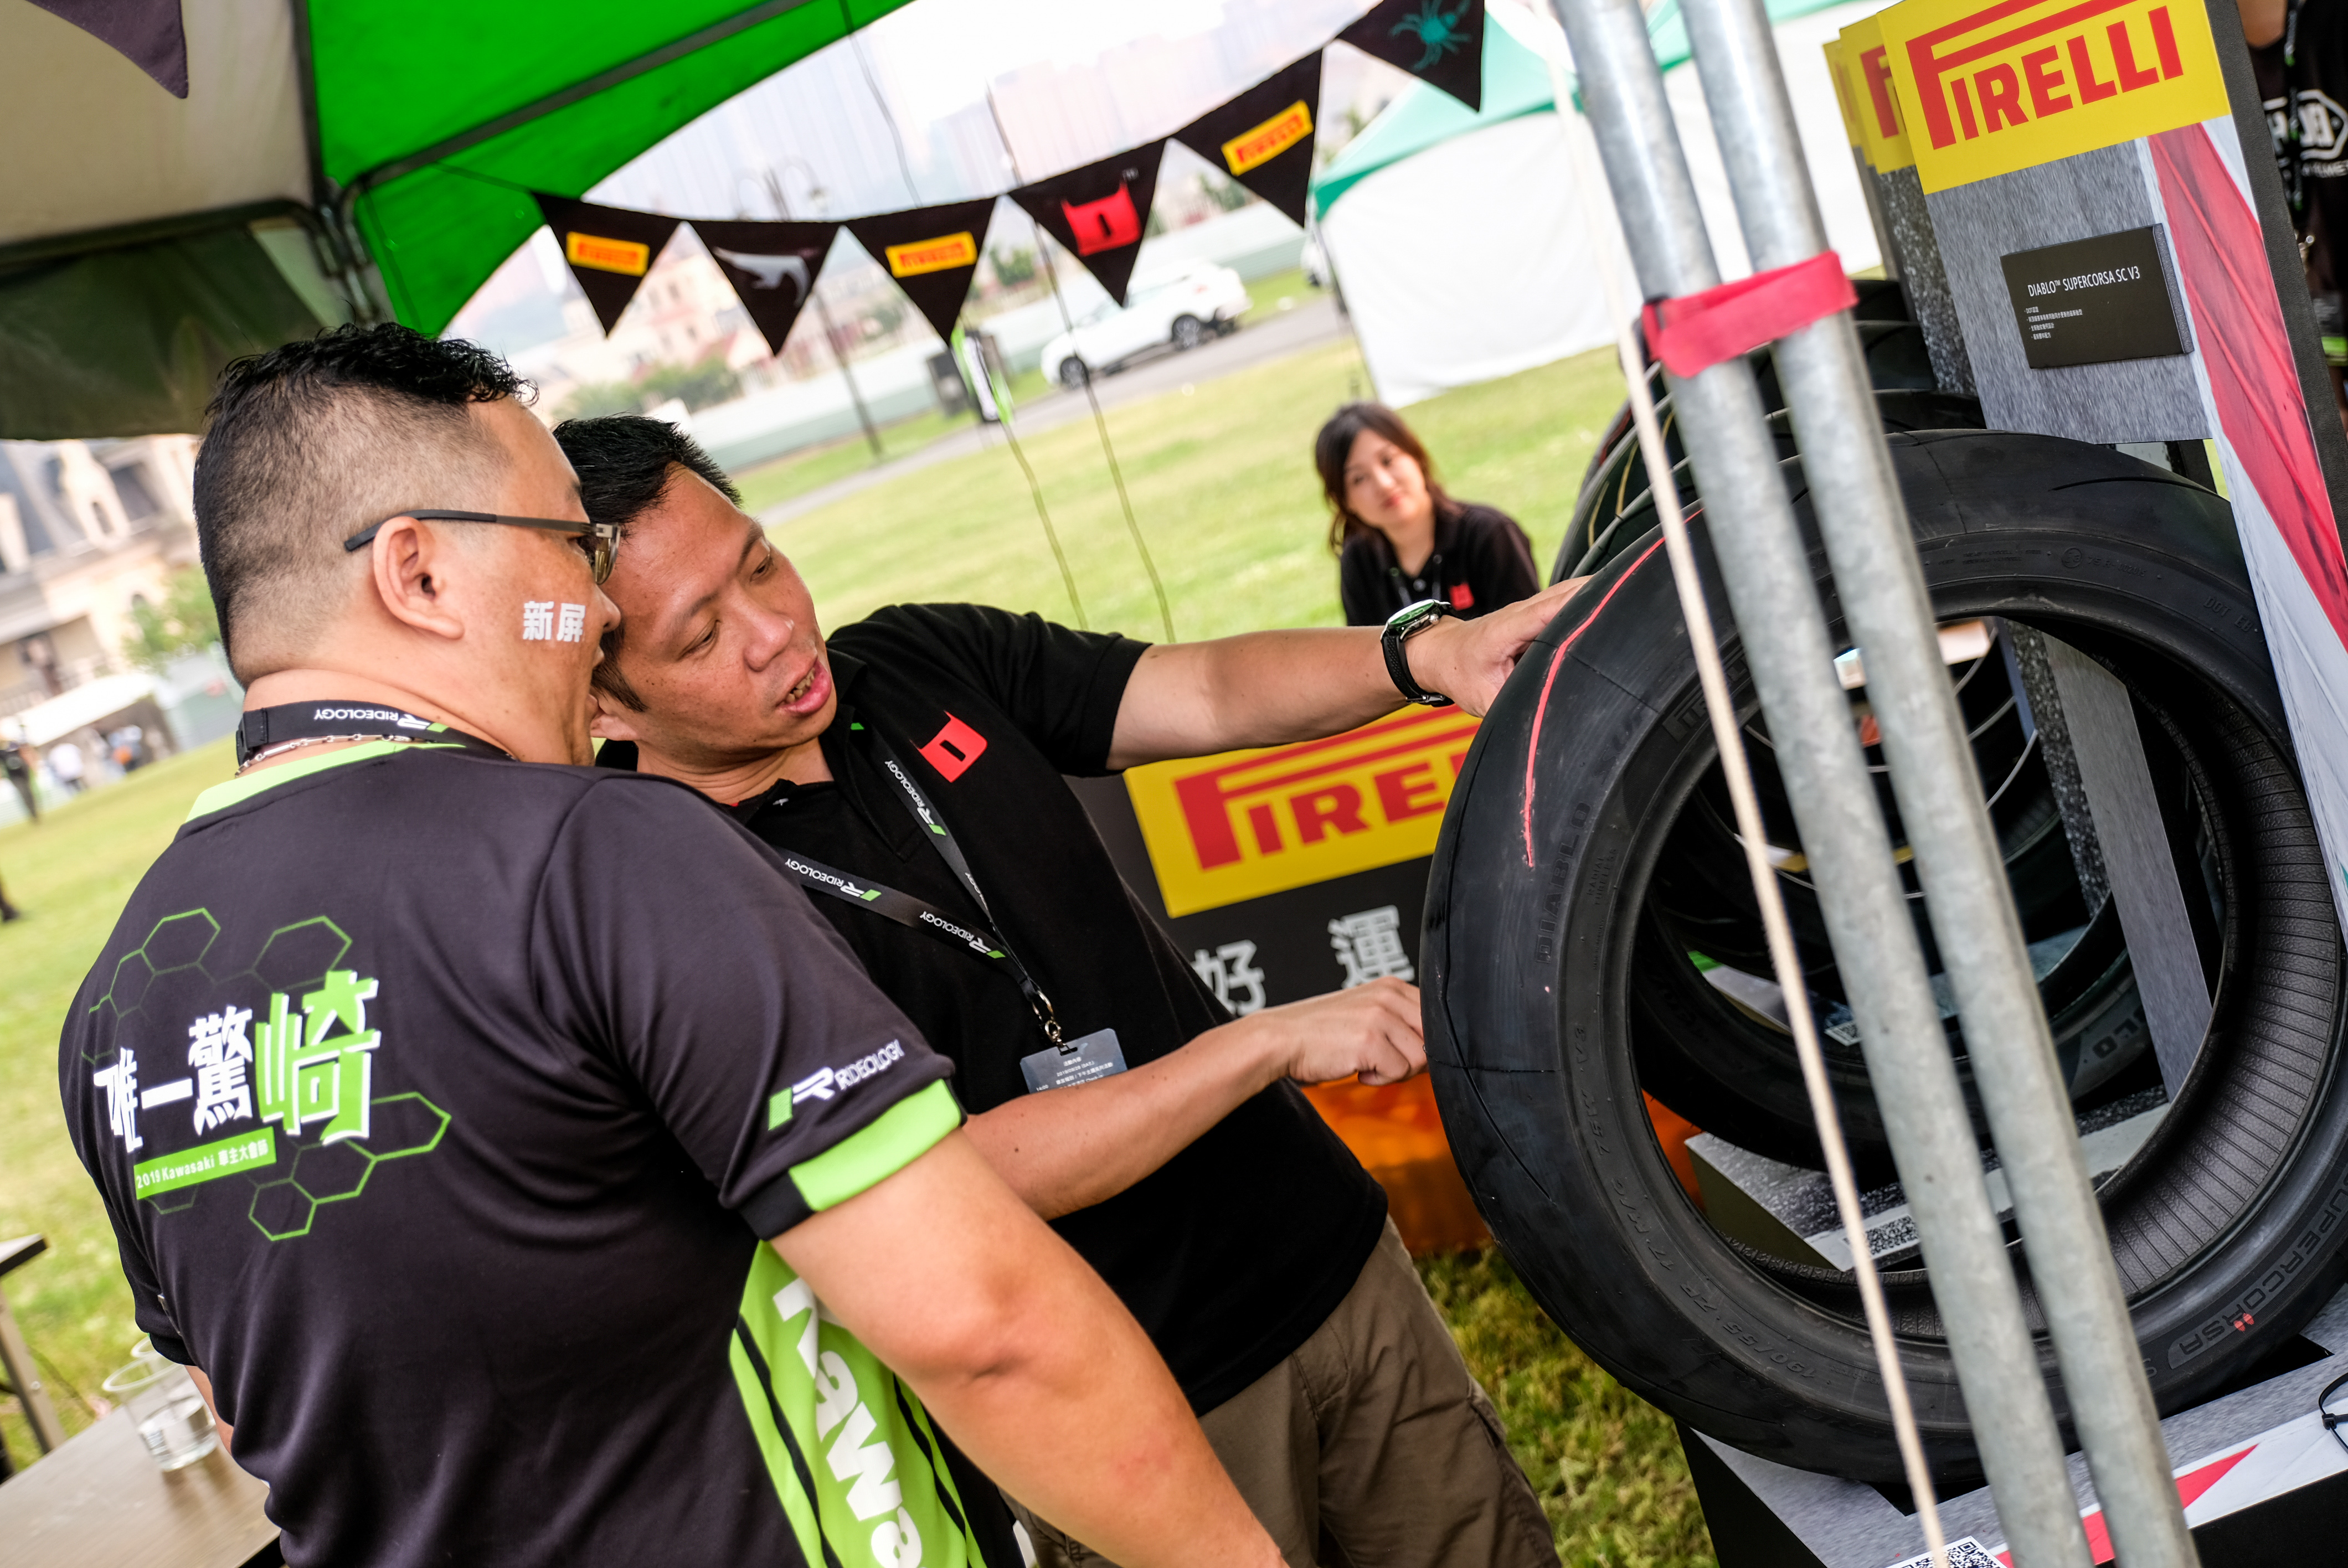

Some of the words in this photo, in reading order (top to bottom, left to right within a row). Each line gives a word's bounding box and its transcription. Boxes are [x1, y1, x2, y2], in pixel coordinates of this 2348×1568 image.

[1905, 0, 2184, 150] PIRELLI
[2062, 270, 2115, 291] SUPERCORSA
[2115, 267, 2128, 282] SC
[2127, 266, 2140, 280] V3
[2203, 595, 2232, 616] DOT
[313, 709, 399, 721] RIDEOLOGY
[884, 760, 925, 809] RIDEOLOGY
[1173, 704, 1486, 872] PIRE
[785, 858, 844, 888] RIDEOLOGY
[1534, 801, 1592, 964] DIABLO
[920, 911, 975, 942] RIDEOLOGY
[835, 1039, 905, 1091] RIDEOLOGY
[1581, 1090, 1611, 1157] 75W
[136, 1169, 161, 1188] 2019
[162, 1155, 215, 1181] Kawasaki
[1647, 1245, 1675, 1272] 17
[2179, 1167, 2348, 1355] UPERCORSA
[1678, 1282, 1718, 1314] ZR
[1721, 1321, 1821, 1382] 190/55
